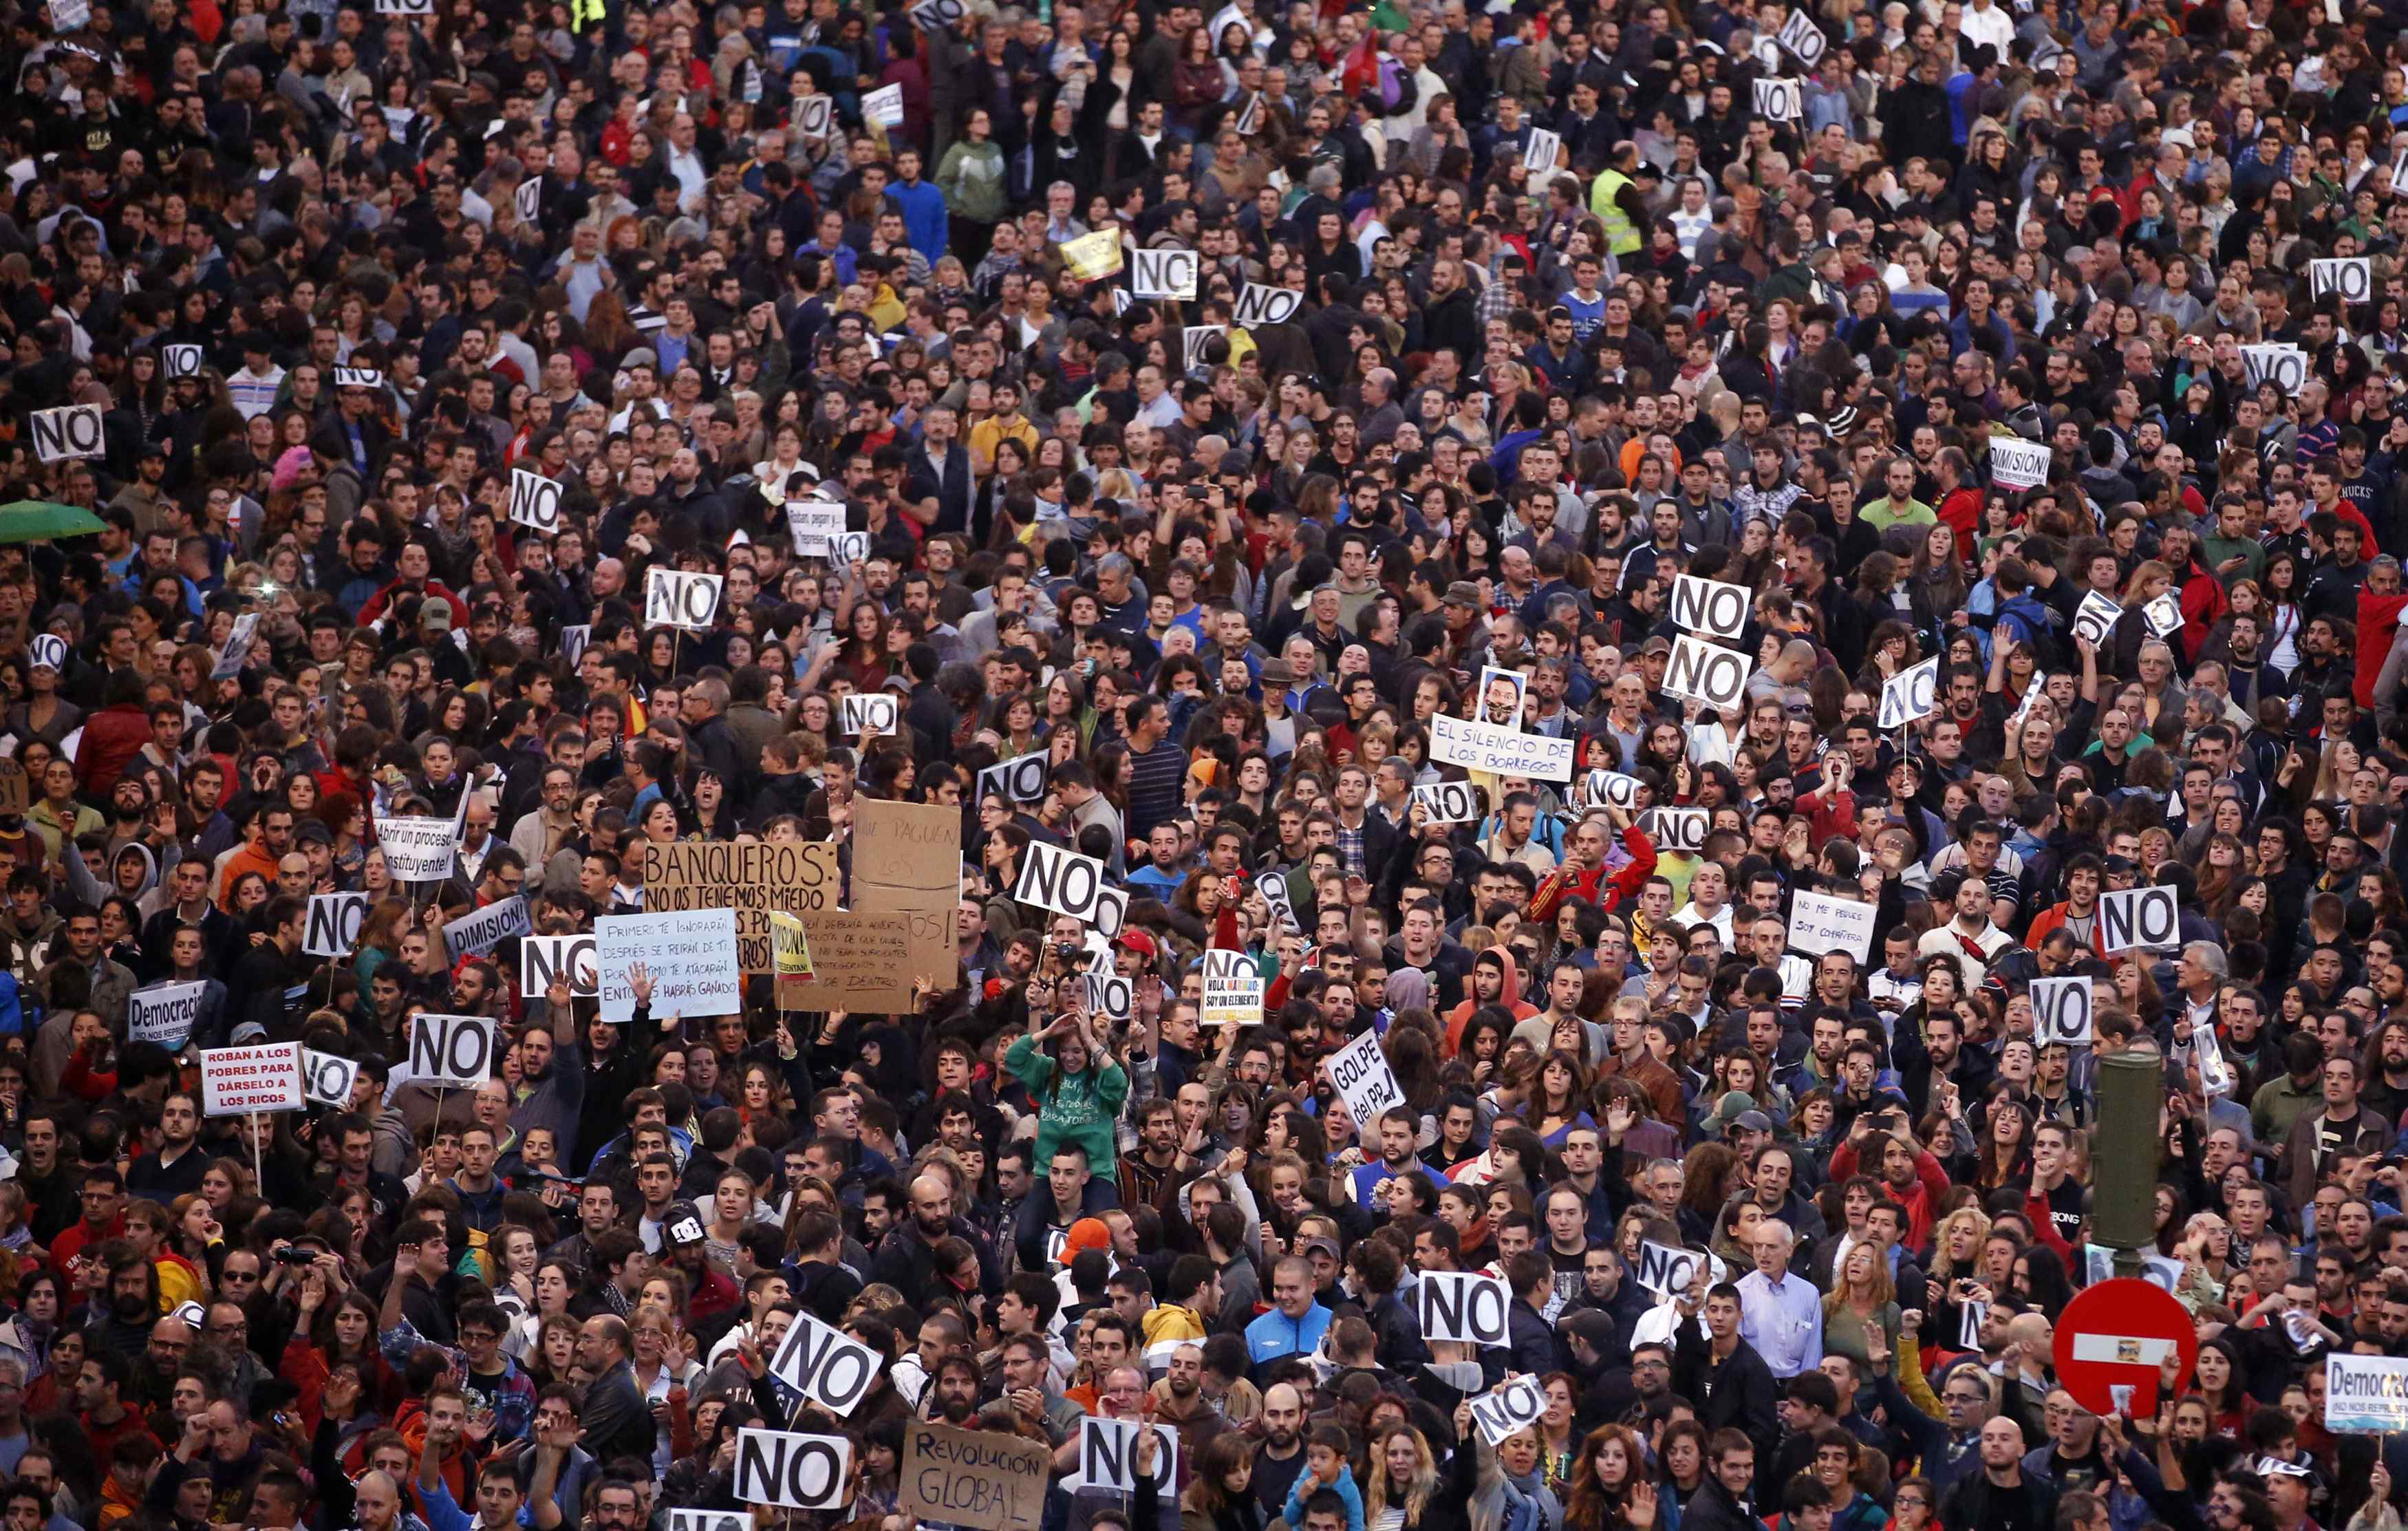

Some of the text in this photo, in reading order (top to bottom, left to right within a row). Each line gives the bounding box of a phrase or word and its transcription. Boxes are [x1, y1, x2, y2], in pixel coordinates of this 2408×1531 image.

[1754, 83, 1787, 118] NO
[1139, 253, 1194, 292] NO
[1238, 286, 1295, 321] NO
[165, 347, 200, 376] NO
[33, 409, 101, 458] NO
[512, 472, 559, 528] NO
[828, 534, 863, 568] NO
[652, 574, 717, 624] NO
[1676, 578, 1744, 634] NO
[32, 636, 65, 668] NO
[1670, 640, 1743, 703] NO
[1882, 665, 1935, 727] NO
[846, 698, 894, 733] NO
[1437, 720, 1454, 739] EL
[1547, 743, 1573, 758] DE
[1449, 745, 1557, 773] LOS BORREGOS
[982, 758, 1045, 799] NO
[1587, 773, 1633, 805] NO
[1418, 784, 1467, 821] NO
[378, 824, 401, 844] Abrir
[402, 830, 413, 841] un
[892, 817, 958, 846] PAGUEN
[1657, 813, 1708, 848] NO
[645, 845, 835, 887] BANQUEROS:
[1020, 845, 1097, 915] NO
[645, 887, 670, 912] NO
[674, 887, 691, 910] OS
[696, 885, 766, 910] TENEMOS
[1798, 901, 1809, 910] NO
[1816, 904, 1829, 914] ME
[308, 897, 365, 952] NO
[455, 903, 525, 951] DIMISIÓN!
[607, 924, 655, 938] PRIMERO
[658, 921, 670, 934] TE
[1796, 921, 1815, 933] SOY
[2103, 890, 2175, 949] NO
[526, 940, 598, 996] NO
[603, 943, 645, 960] DESPUÉS
[652, 944, 661, 956] SE
[668, 939, 698, 956] REIRÁN
[703, 942, 713, 954] DE
[1205, 951, 1260, 978] NO
[605, 967, 625, 981] POR
[671, 964, 682, 978] TE
[685, 960, 733, 976] ATACARÁN.
[664, 980, 696, 998] HABRÁS
[698, 980, 737, 996] GANADO
[846, 975, 899, 987] DENTRO
[1086, 975, 1130, 1017] NO
[1206, 996, 1218, 1007] SOY
[1229, 995, 1259, 1006] ELEMENTO
[2032, 983, 2088, 1039] NO
[208, 1048, 292, 1062] ROBAN A LOS
[412, 1019, 488, 1079] NO
[1335, 1038, 1380, 1091] GOLPE
[208, 1063, 294, 1078] POBRES PARA
[217, 1078, 287, 1091] DÁRSELO A
[220, 1093, 286, 1106] LOS RICOS
[1353, 1093, 1370, 1125] del
[1641, 1245, 1695, 1295] NO
[1423, 1276, 1505, 1343] NO
[775, 1318, 870, 1409] NO
[1474, 1382, 1538, 1443] NO
[738, 1435, 841, 1507] NO
[1086, 1422, 1174, 1494] NO
[918, 1468, 1028, 1521] GLOBAL
